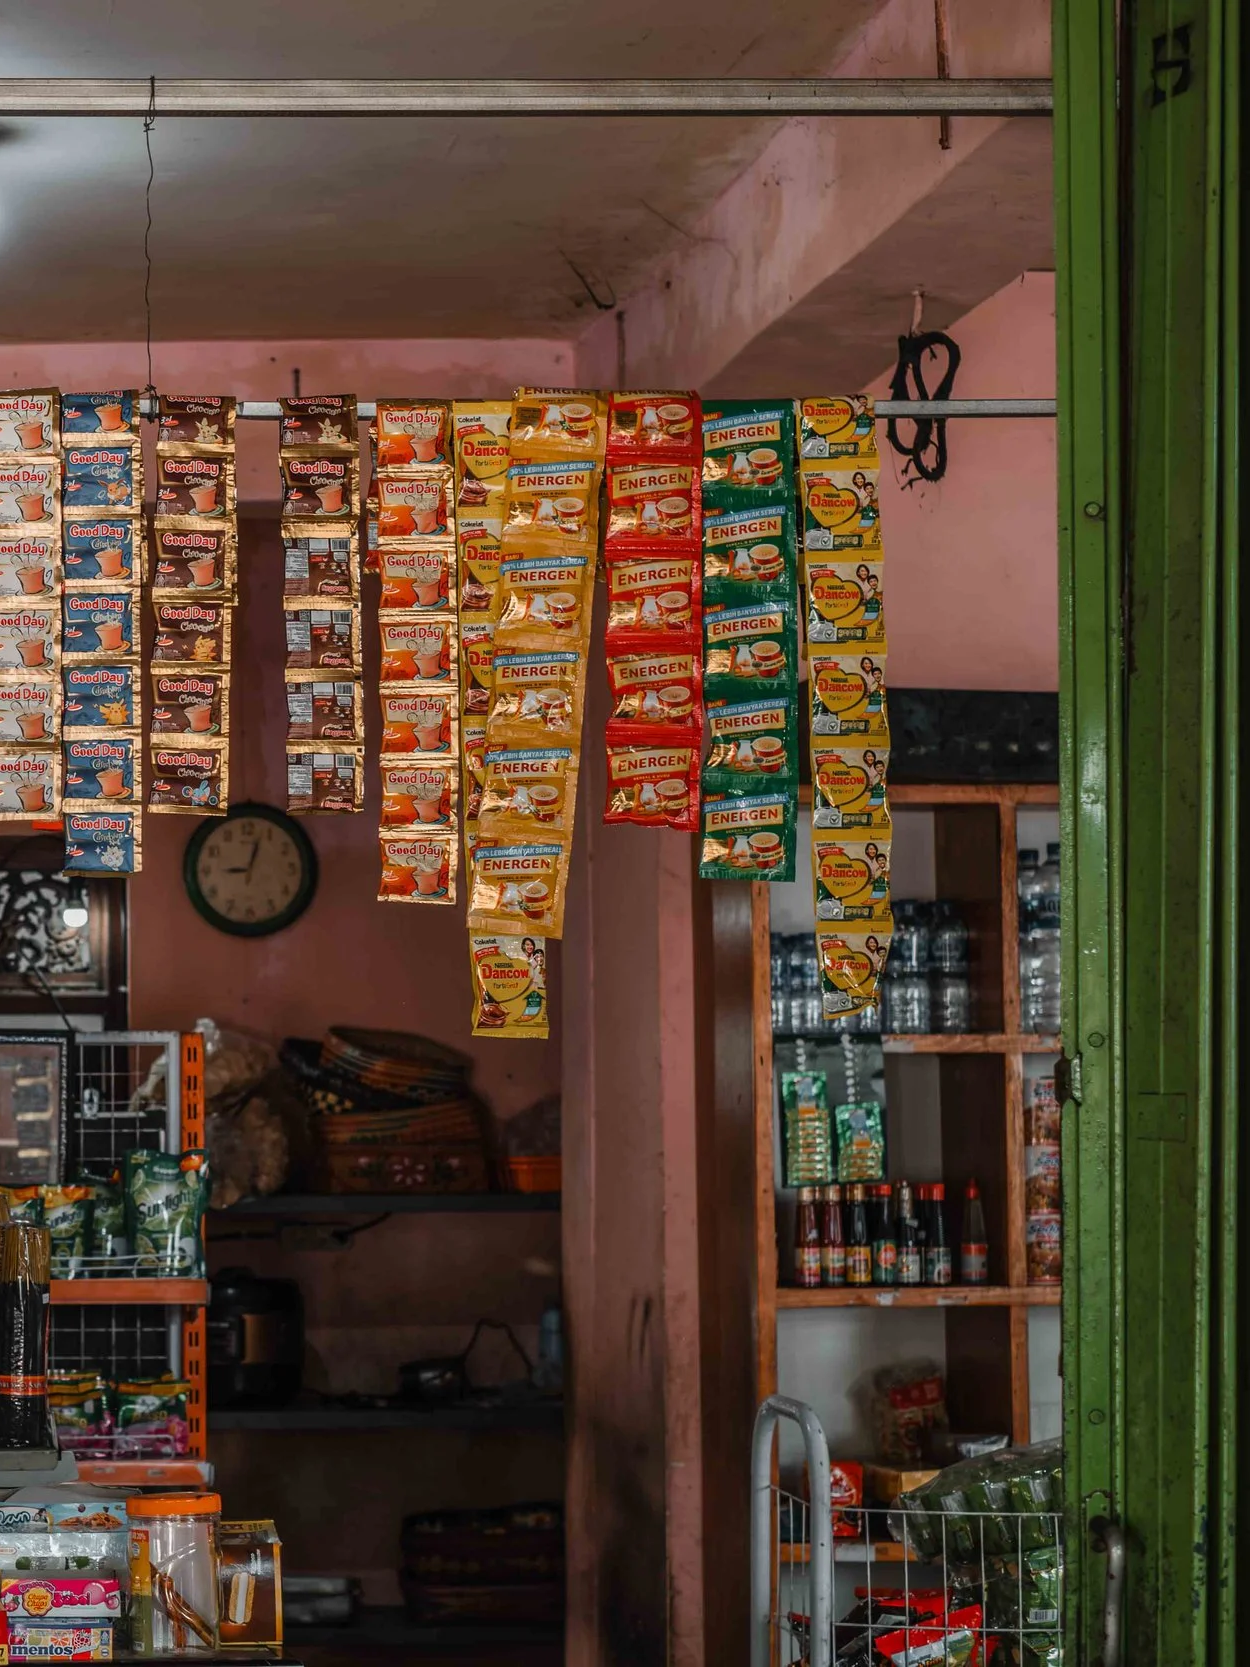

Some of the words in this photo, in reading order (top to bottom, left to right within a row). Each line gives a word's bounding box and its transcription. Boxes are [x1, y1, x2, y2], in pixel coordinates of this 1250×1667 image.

[21, 400, 44, 412] Day
[803, 404, 850, 417] Dancow
[385, 413, 413, 423] Good
[415, 413, 438, 424] Day
[715, 420, 733, 429] LEBIH
[733, 415, 759, 426] BANYAK
[758, 411, 783, 421] SEREAL
[709, 425, 775, 444] ENERGEN
[70, 452, 99, 464] Good
[101, 451, 124, 465] Day
[164, 460, 194, 473] Good
[196, 461, 219, 476] Day
[290, 462, 319, 474] Good
[321, 462, 344, 476] Day
[524, 465, 541, 474] LEBIH
[541, 463, 568, 472] BANYAK
[517, 475, 585, 488] ENERGEN
[619, 473, 689, 491] ENERGEN
[810, 494, 856, 507] Dancow
[711, 520, 778, 540] ENERGEN
[509, 570, 577, 583] ENERGEN
[618, 567, 689, 586] ENERGEN
[813, 585, 860, 600] Dancow
[161, 607, 190, 619] Good
[193, 607, 216, 621] Day
[23, 615, 45, 629] Day
[70, 671, 99, 684] Good
[101, 671, 124, 685] Day
[501, 666, 568, 678] ENERGEN
[817, 678, 864, 693] Dancow
[714, 713, 780, 730] ENERGEN
[23, 760, 45, 773] Day
[158, 753, 187, 765] Good
[190, 754, 212, 768] Day
[617, 755, 687, 773] ENERGEN
[388, 773, 417, 783] Good
[419, 773, 441, 785] Day
[819, 771, 865, 786] Dancow
[72, 817, 100, 829] Good
[102, 817, 125, 830] Day
[483, 858, 550, 871] ENERGEN
[822, 864, 867, 878] Dancow
[481, 964, 530, 980] Dancow
[12, 1645, 73, 1656] mentos
